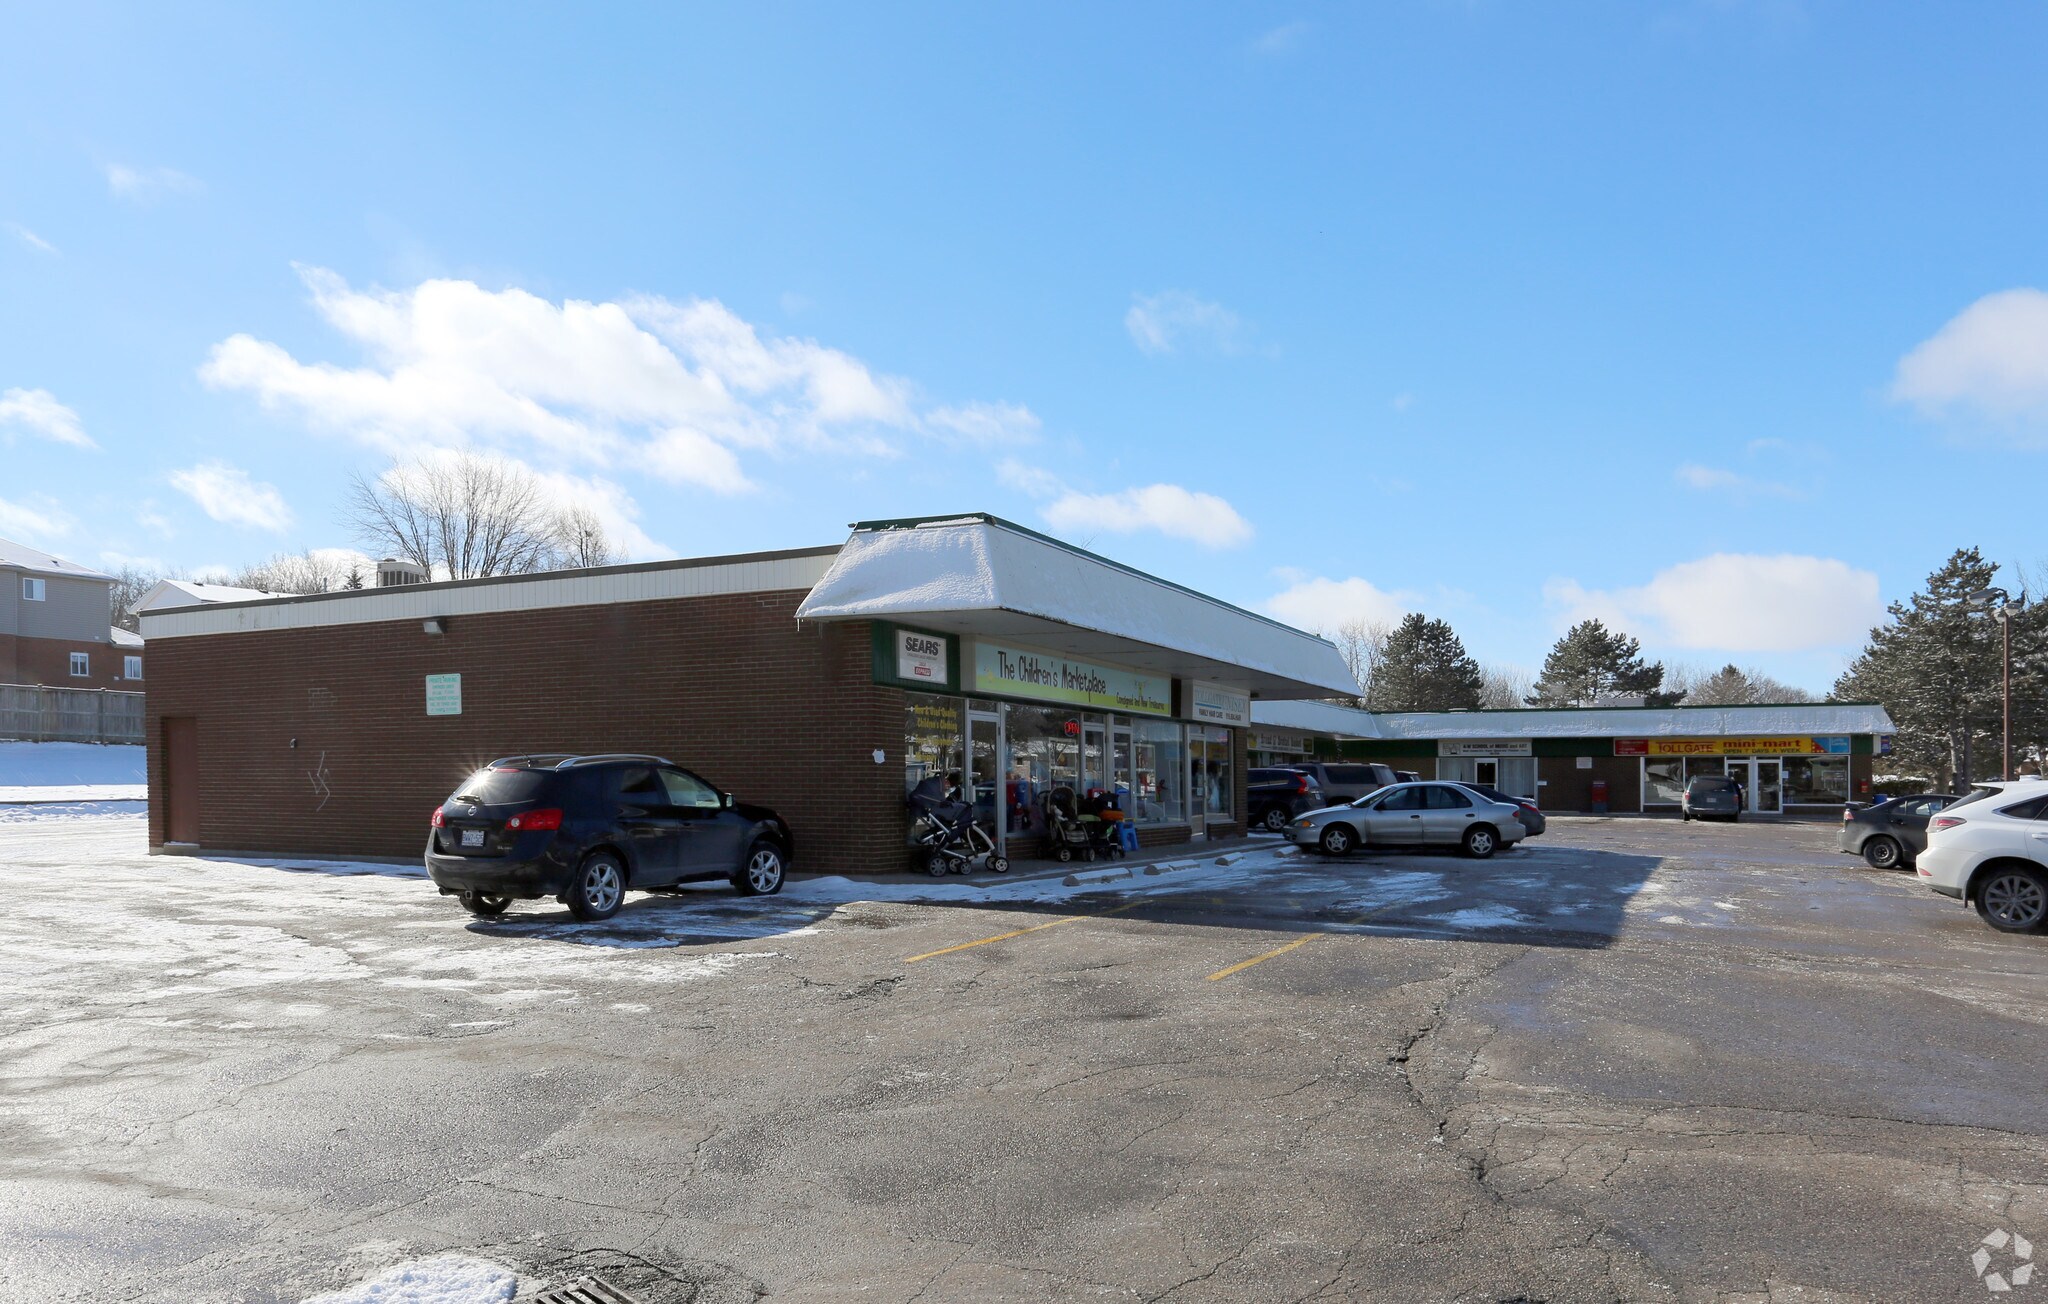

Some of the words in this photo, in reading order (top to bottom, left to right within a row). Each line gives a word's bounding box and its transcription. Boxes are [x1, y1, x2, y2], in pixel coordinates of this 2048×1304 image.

[905, 636, 938, 656] SEARS
[998, 650, 1015, 680] The
[1019, 655, 1058, 687] Children's
[1062, 663, 1106, 703] Marketplace
[1064, 722, 1080, 734] OPEN
[1656, 741, 1716, 753] TOLLGATE
[1723, 739, 1801, 748] mini-mart
